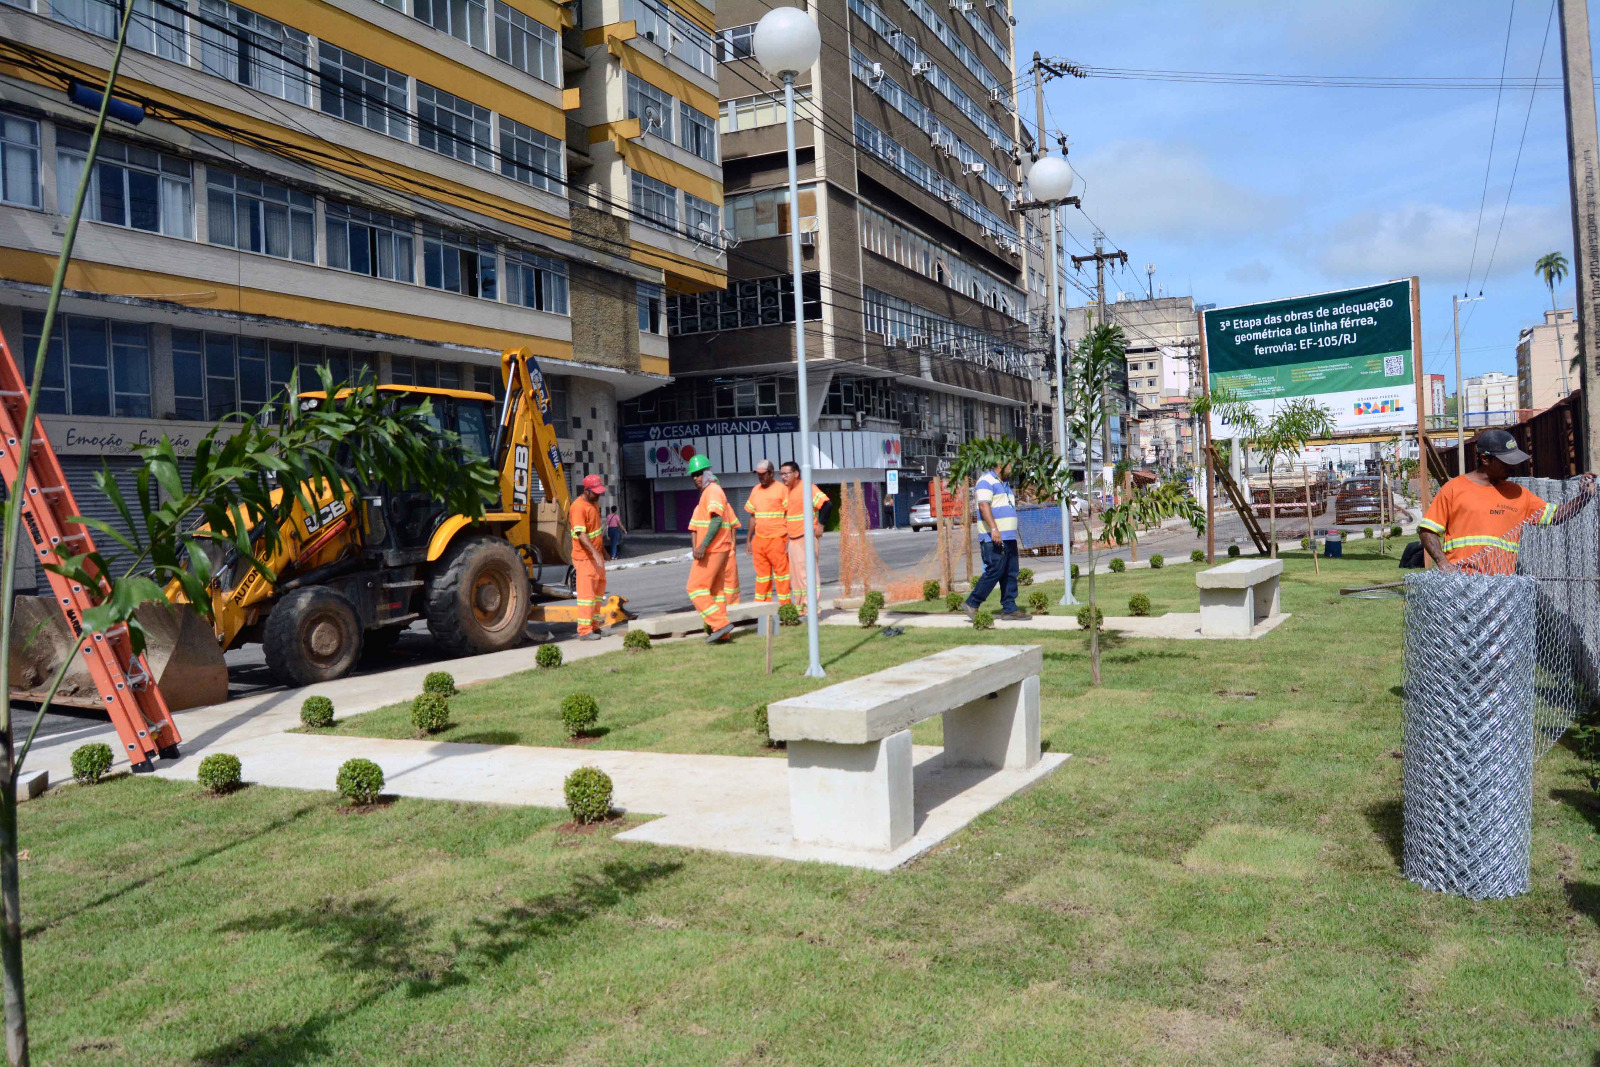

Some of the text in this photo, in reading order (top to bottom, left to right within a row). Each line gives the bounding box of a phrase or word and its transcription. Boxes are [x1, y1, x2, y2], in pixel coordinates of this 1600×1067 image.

[1220, 298, 1393, 331] 3ª Etapa das obras de adequação
[1235, 316, 1377, 345] geométrica da linha férrea,
[1254, 333, 1357, 355] ferrovia: EF-105/RJ
[1354, 399, 1404, 415] BRASIL
[66, 428, 123, 450] Emoção
[662, 425, 700, 438] CESAR
[706, 421, 771, 434] MIRANDA
[513, 445, 529, 512] JCB
[304, 501, 347, 534] JCB
